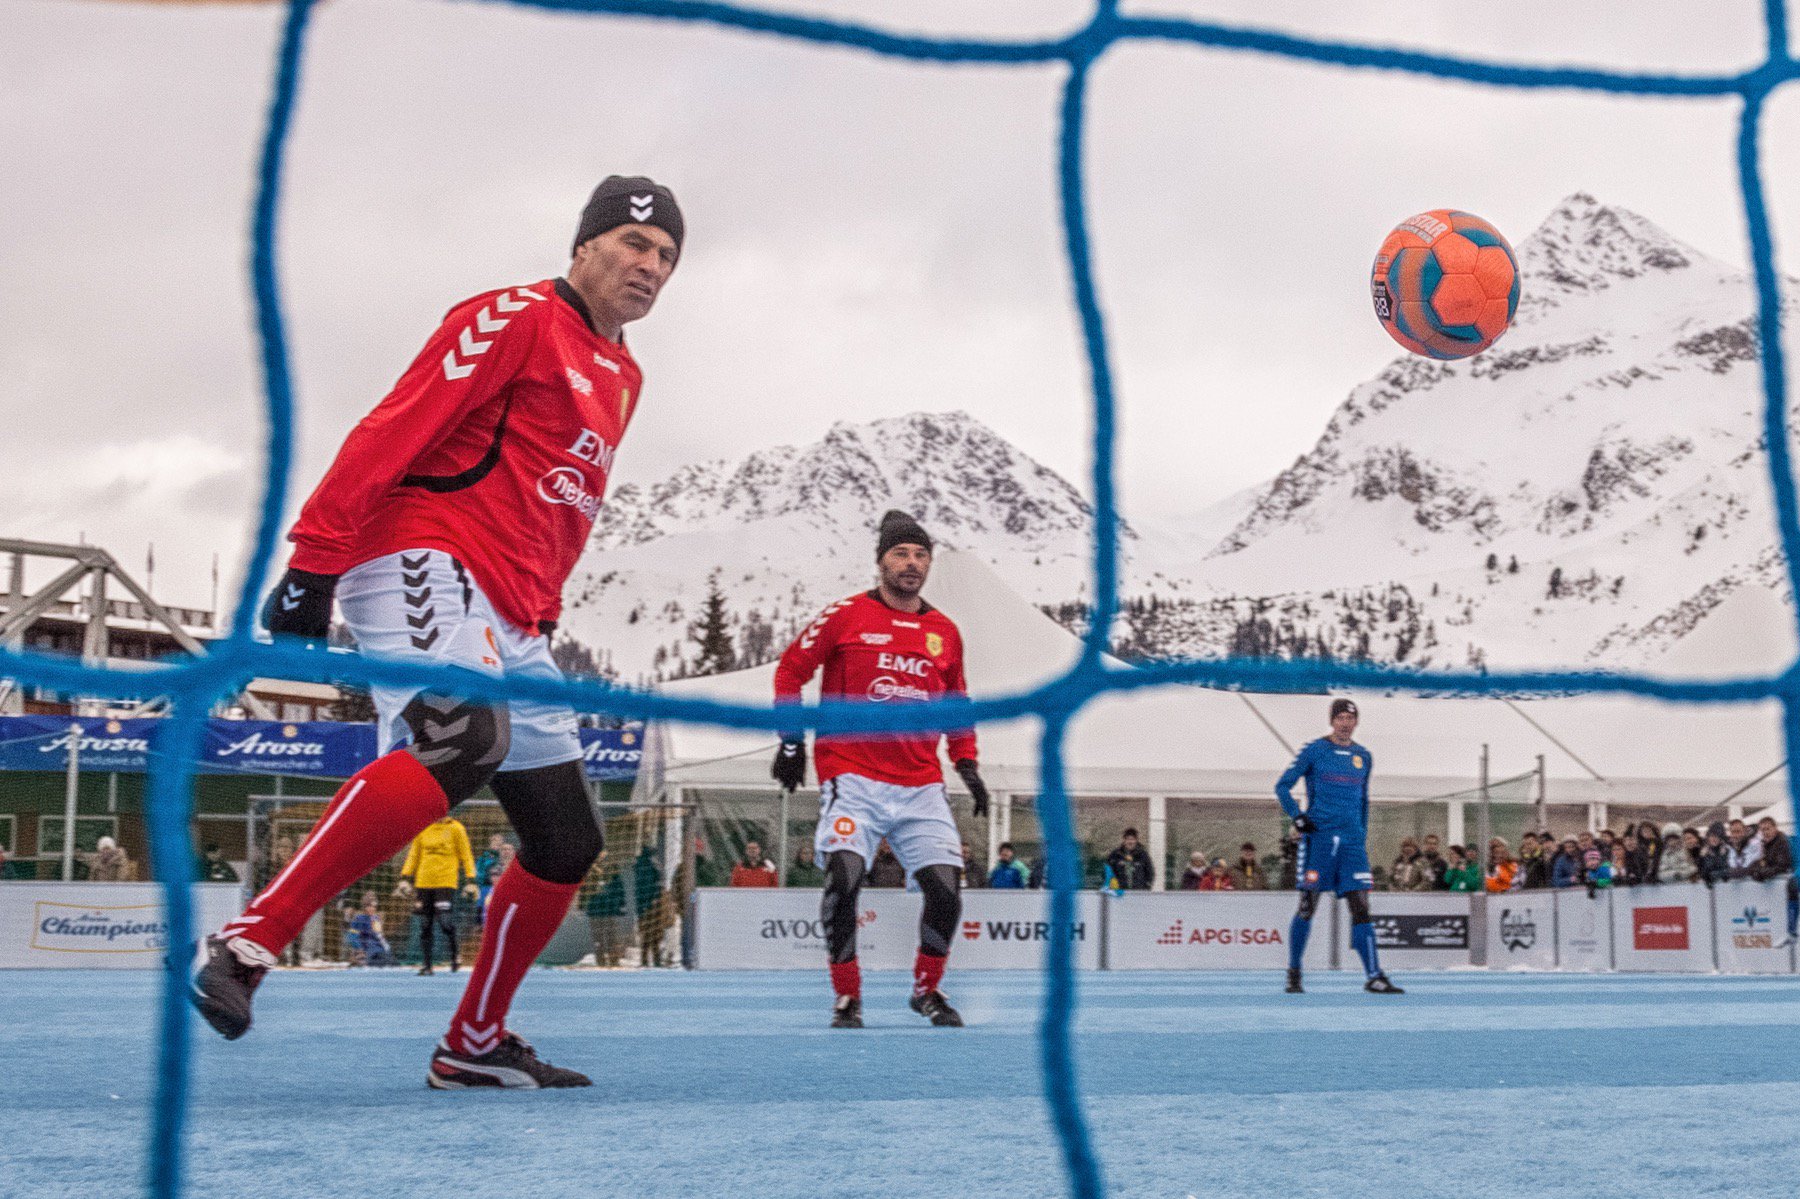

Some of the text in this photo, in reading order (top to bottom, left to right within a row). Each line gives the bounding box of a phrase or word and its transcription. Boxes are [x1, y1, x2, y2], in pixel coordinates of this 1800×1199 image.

[217, 732, 324, 756] Arosa
[581, 740, 641, 762] Aros
[987, 921, 1085, 941] WÜRH
